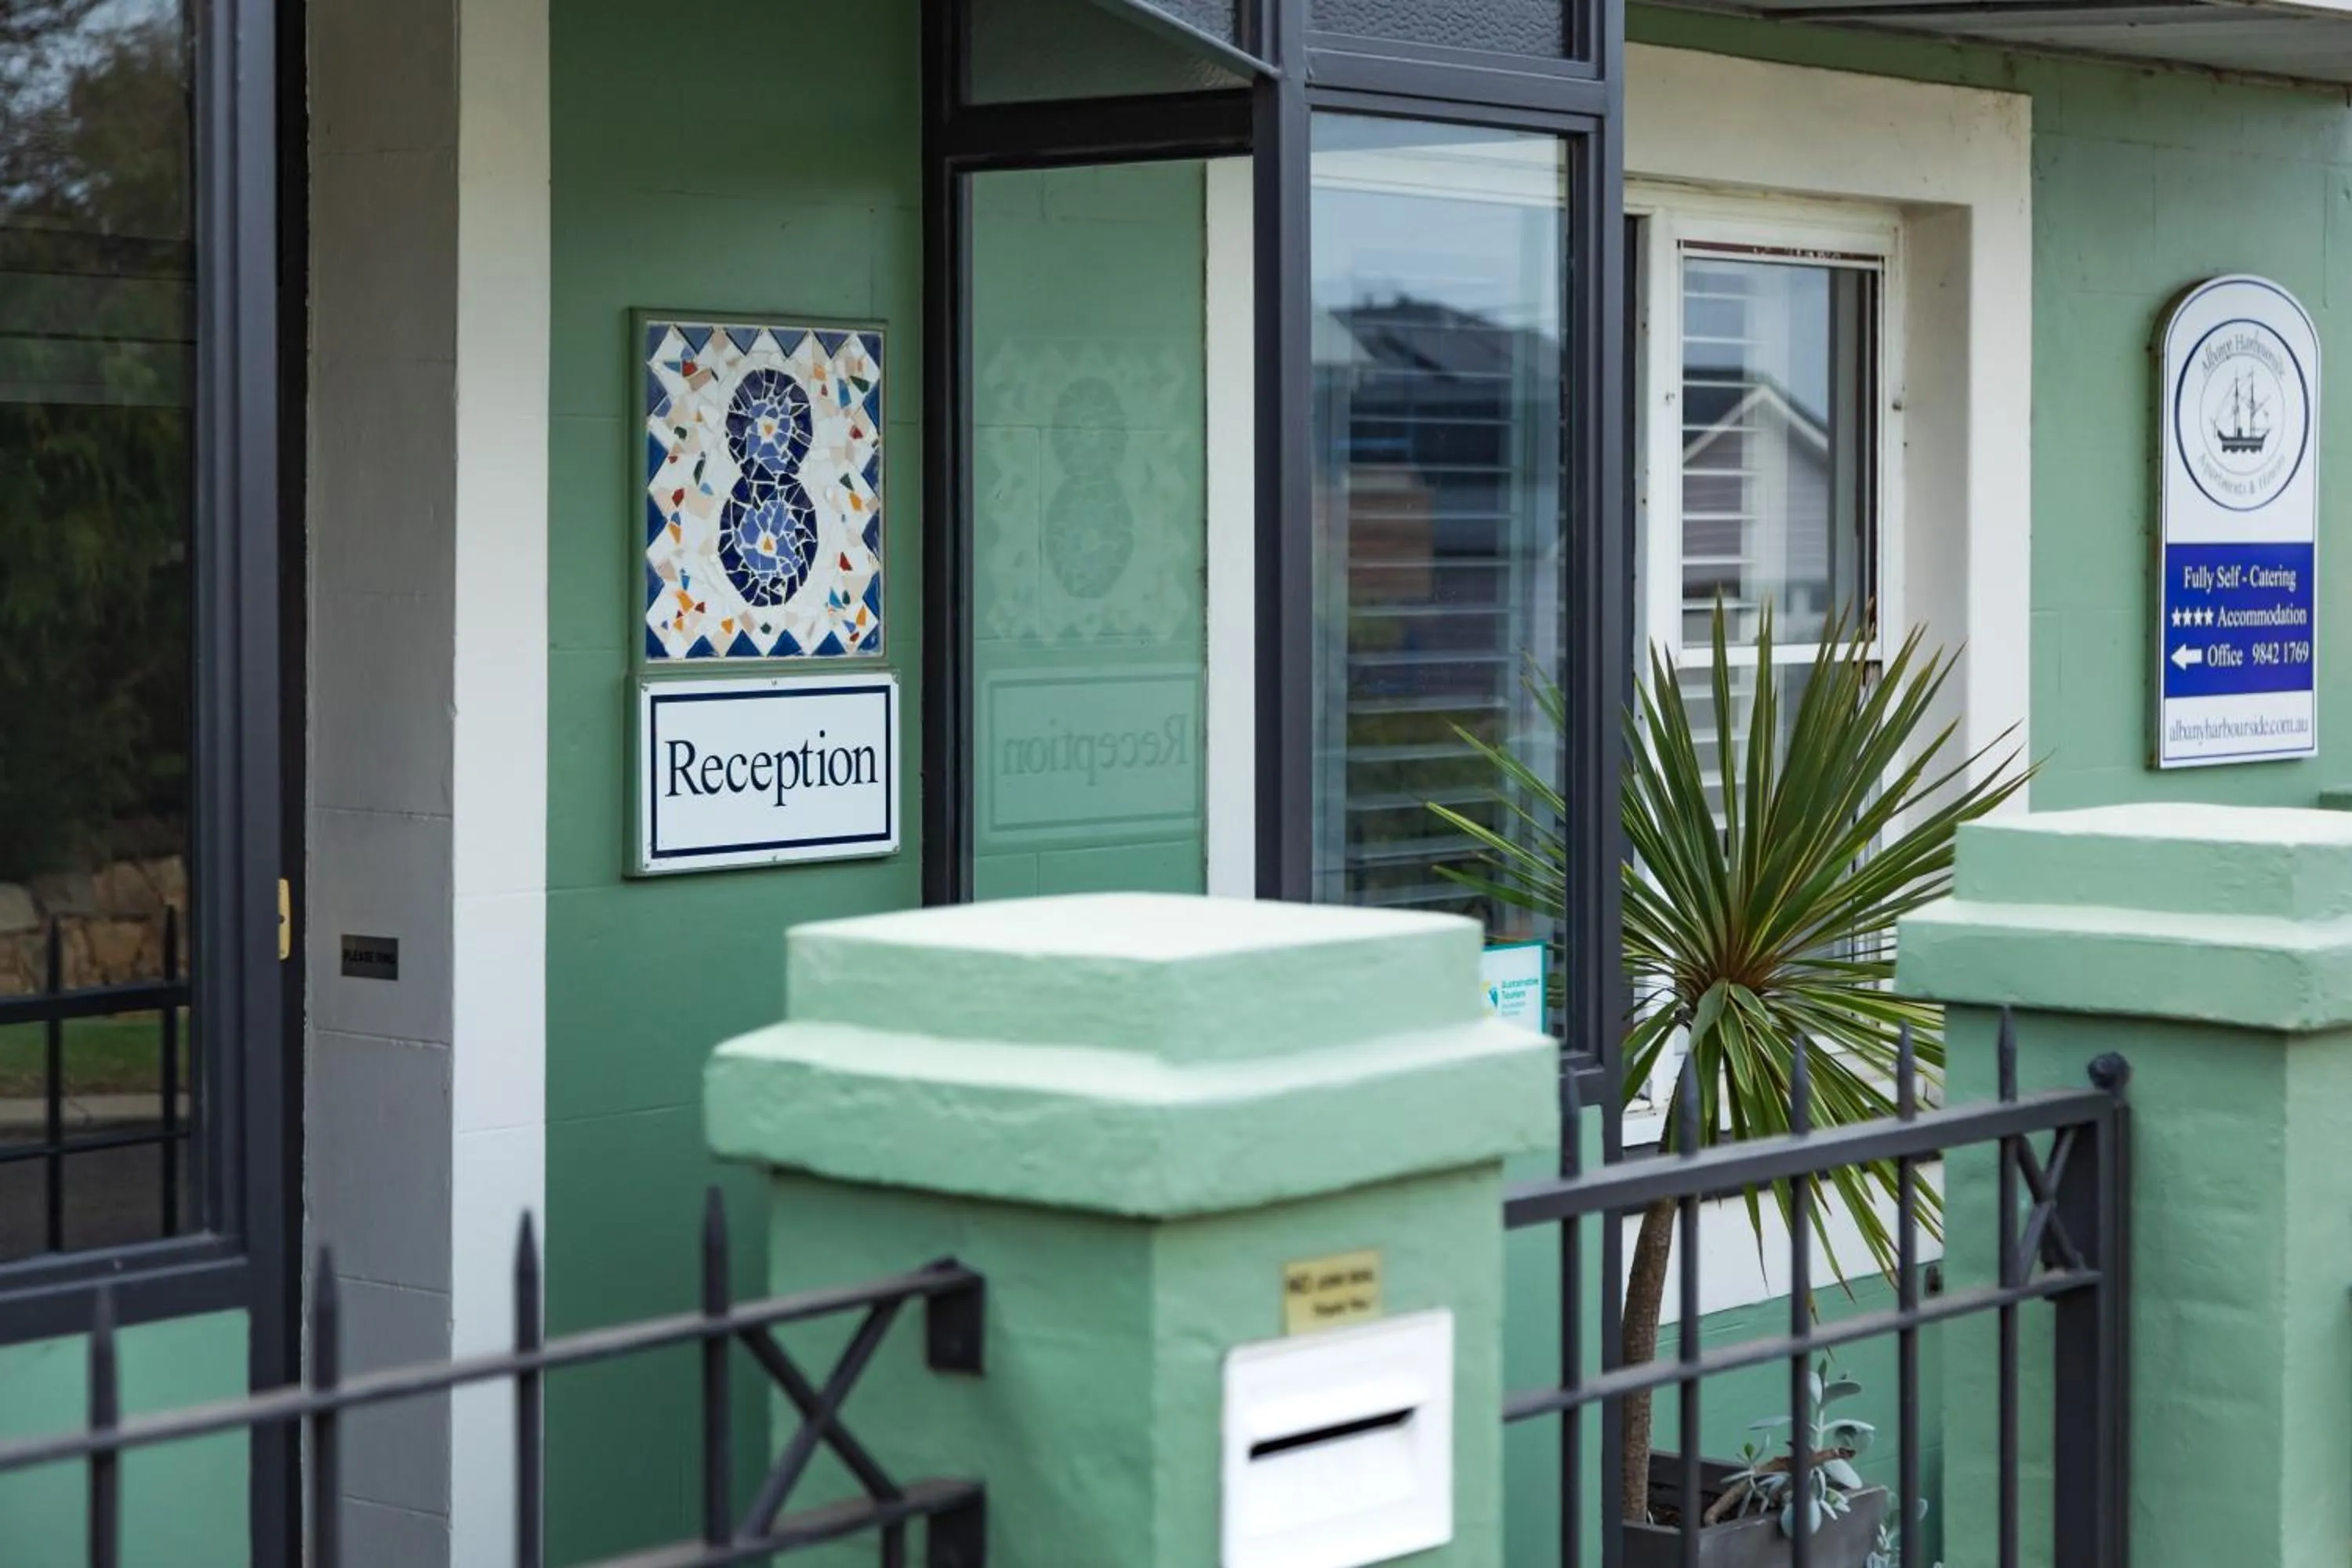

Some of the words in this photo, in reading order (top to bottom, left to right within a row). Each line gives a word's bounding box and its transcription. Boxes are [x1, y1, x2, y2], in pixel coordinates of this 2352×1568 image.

[717, 367, 818, 607] 8
[2183, 564, 2214, 594] Fully
[2216, 564, 2242, 589] Self
[2249, 564, 2296, 593] Catering
[2217, 603, 2307, 627] Accommodation
[2207, 643, 2243, 667] Office
[2252, 641, 2279, 665] 9842
[2283, 641, 2309, 664] 1769
[2169, 715, 2309, 746] albanyharbourside.com.au
[665, 729, 879, 807] Reception
